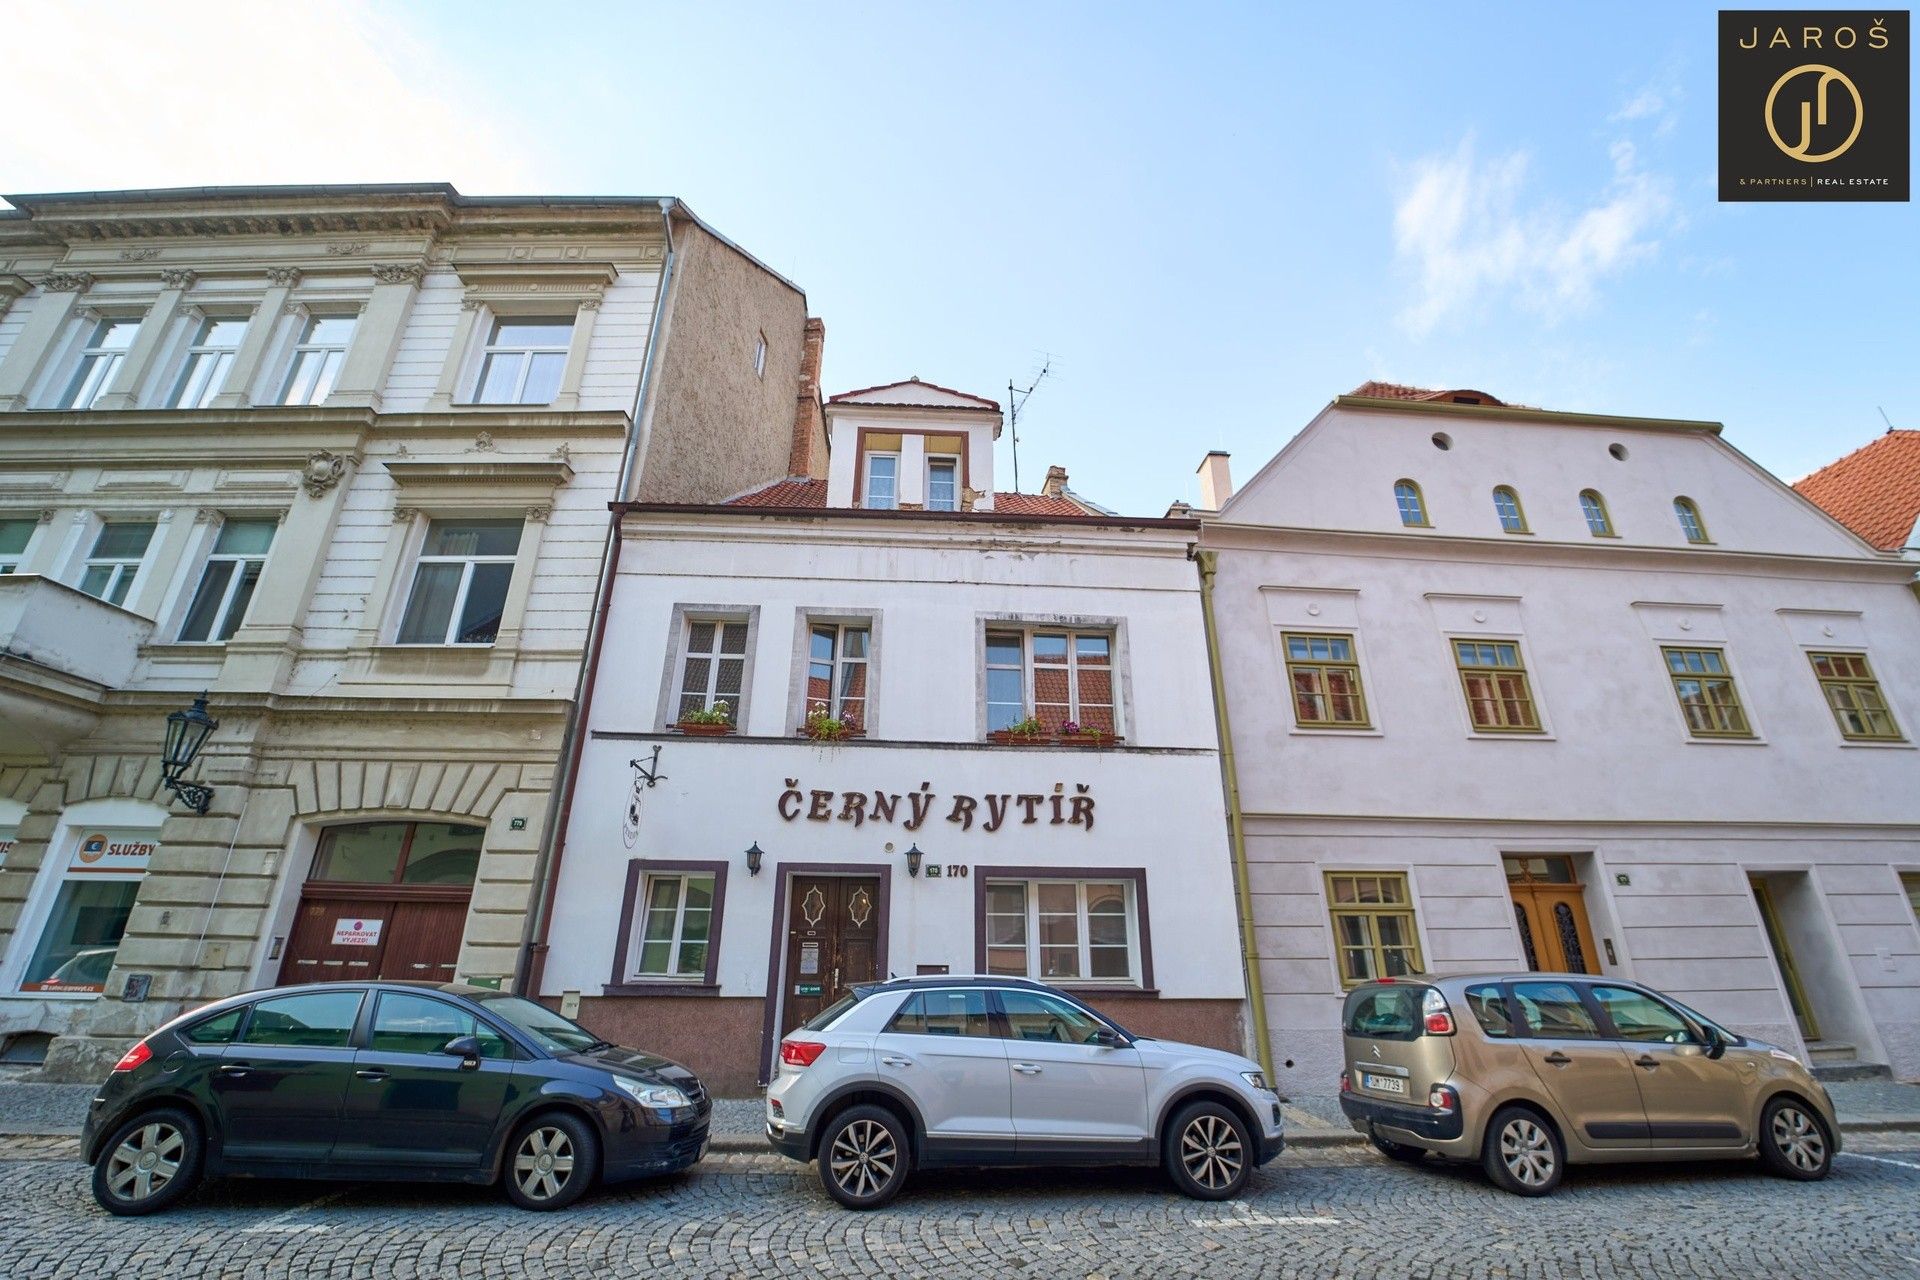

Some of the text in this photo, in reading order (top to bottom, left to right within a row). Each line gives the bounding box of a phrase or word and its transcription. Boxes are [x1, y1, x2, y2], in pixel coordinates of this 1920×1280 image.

[778, 778, 1095, 832] ČERNÝ RYTÍŘ
[107, 841, 156, 856] SLUŽBY
[947, 864, 969, 878] 170
